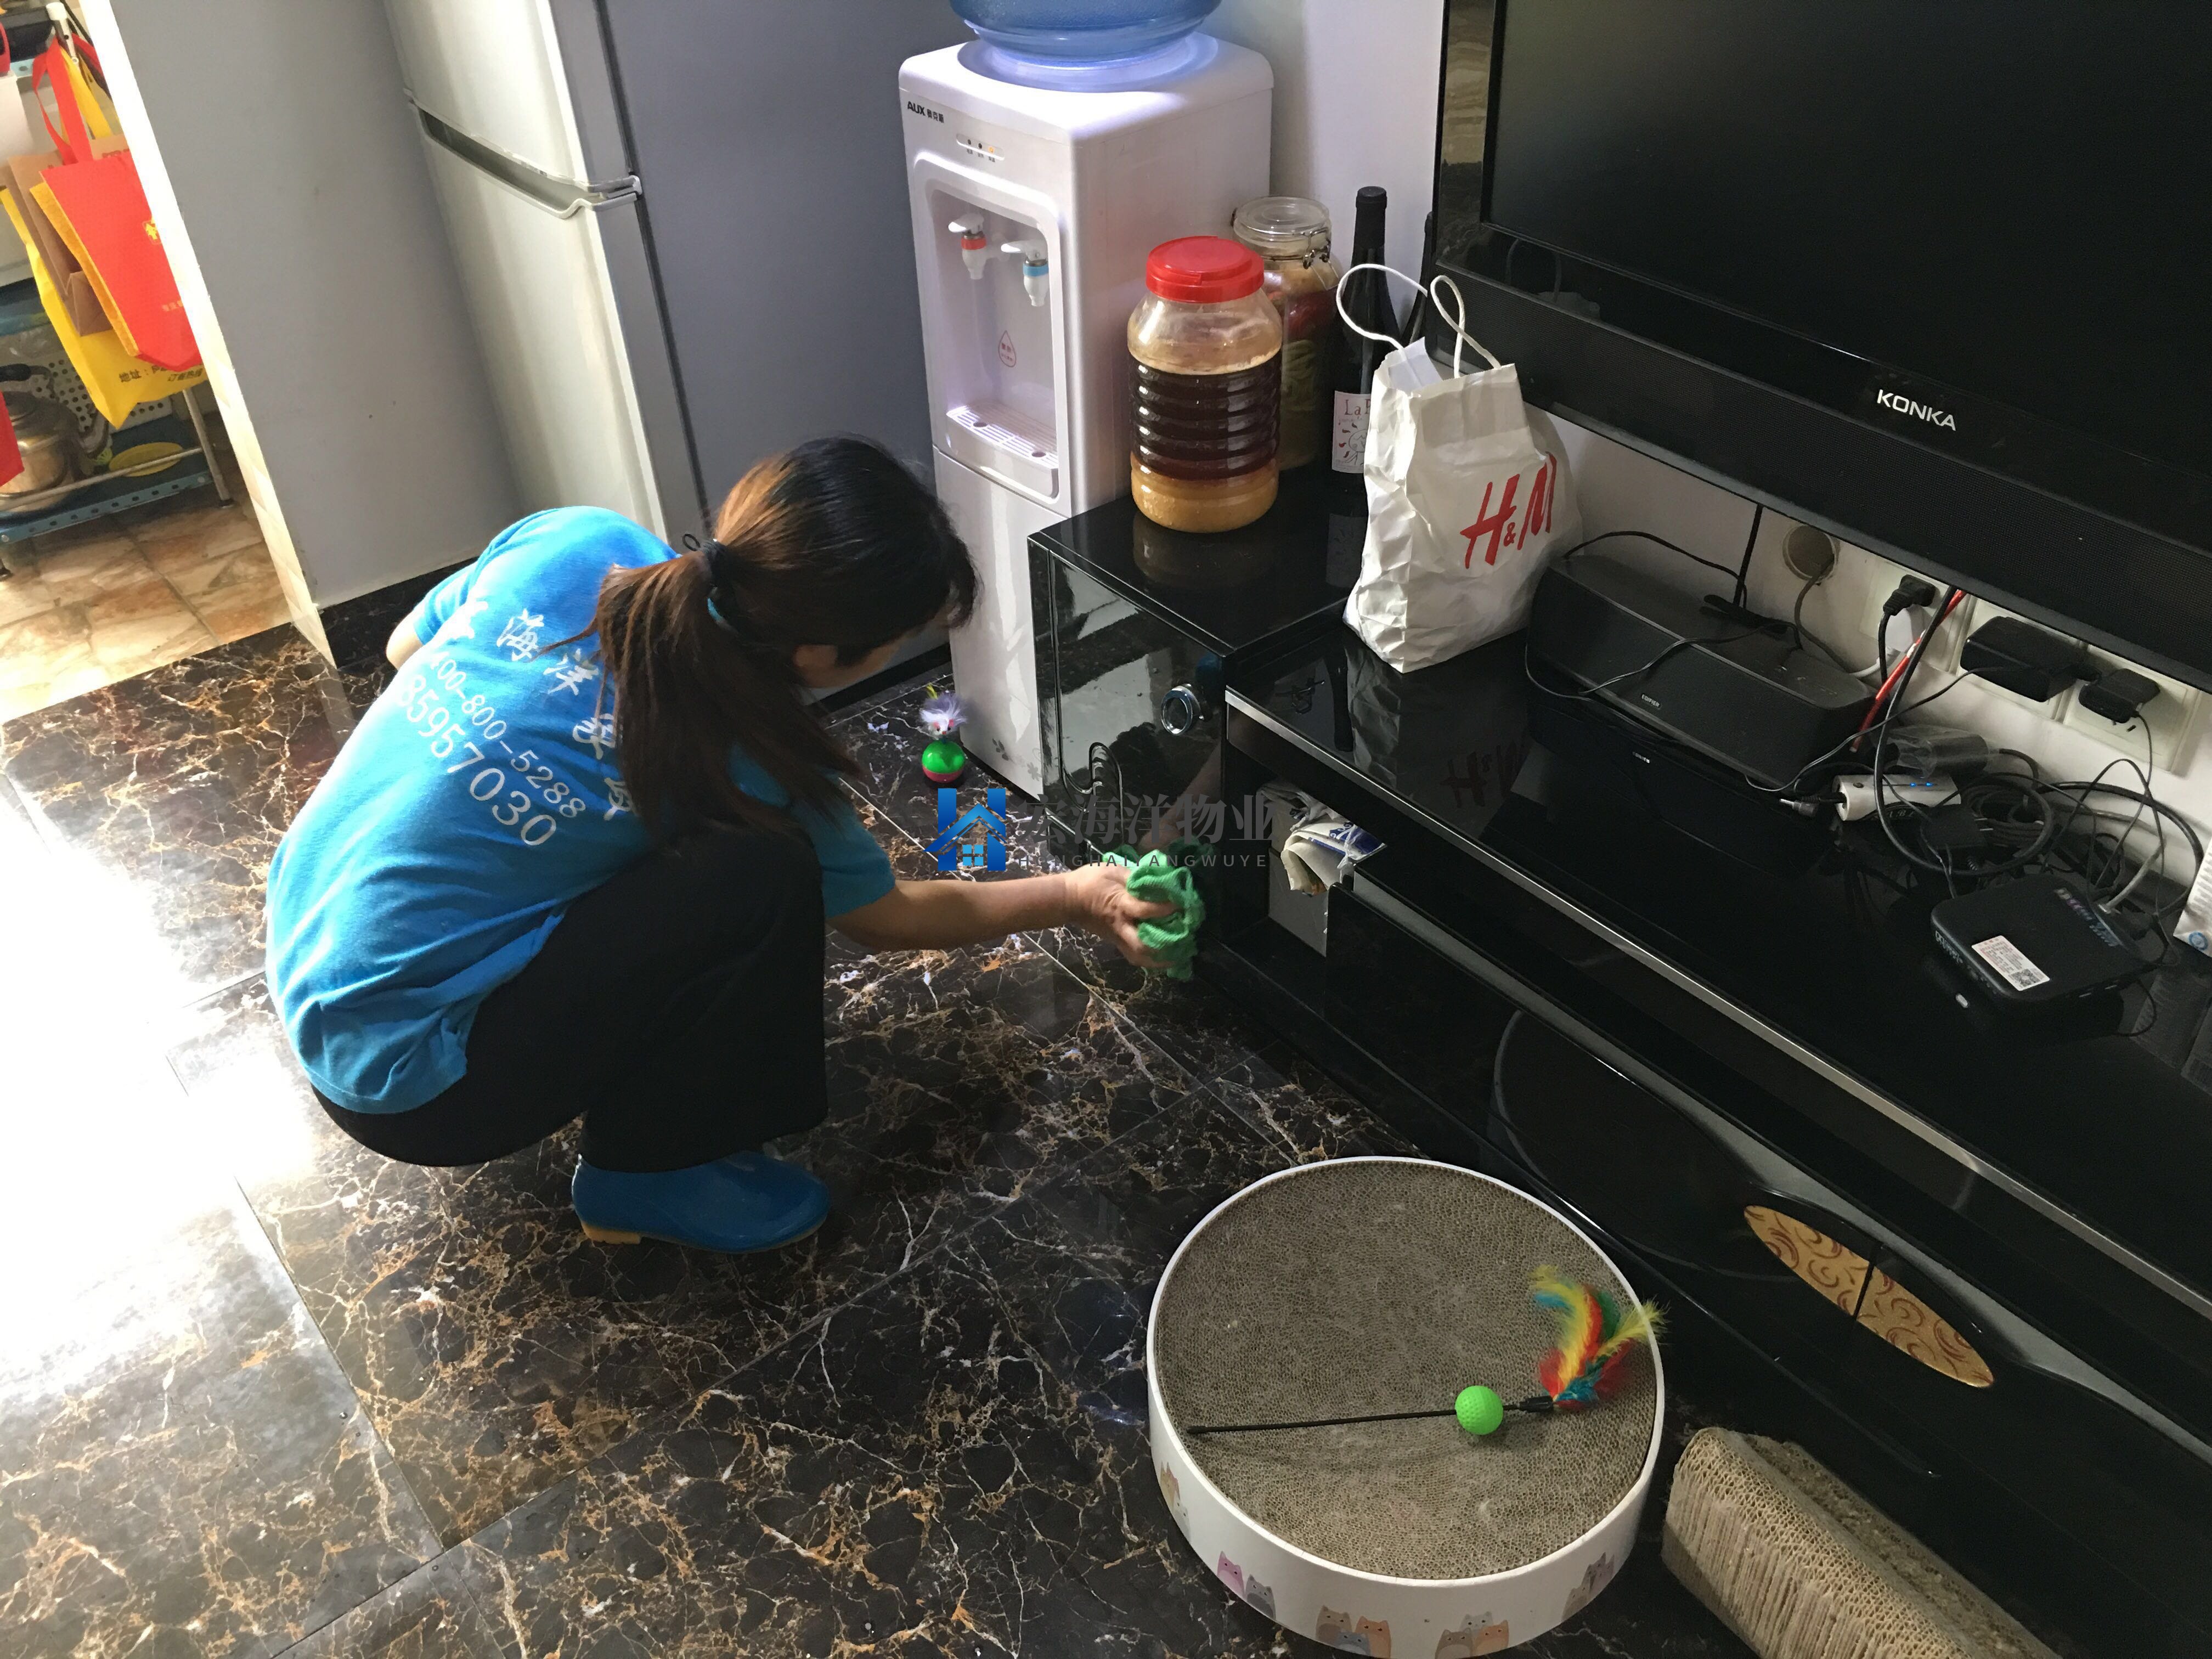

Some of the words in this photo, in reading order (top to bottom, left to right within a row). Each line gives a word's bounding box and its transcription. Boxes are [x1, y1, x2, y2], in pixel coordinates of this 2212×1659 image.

[907, 101, 926, 116] AUX
[1345, 399, 1361, 415] La
[1877, 389, 1956, 431] KONKA
[1460, 451, 1557, 569] H&M
[397, 675, 556, 846] 85957030
